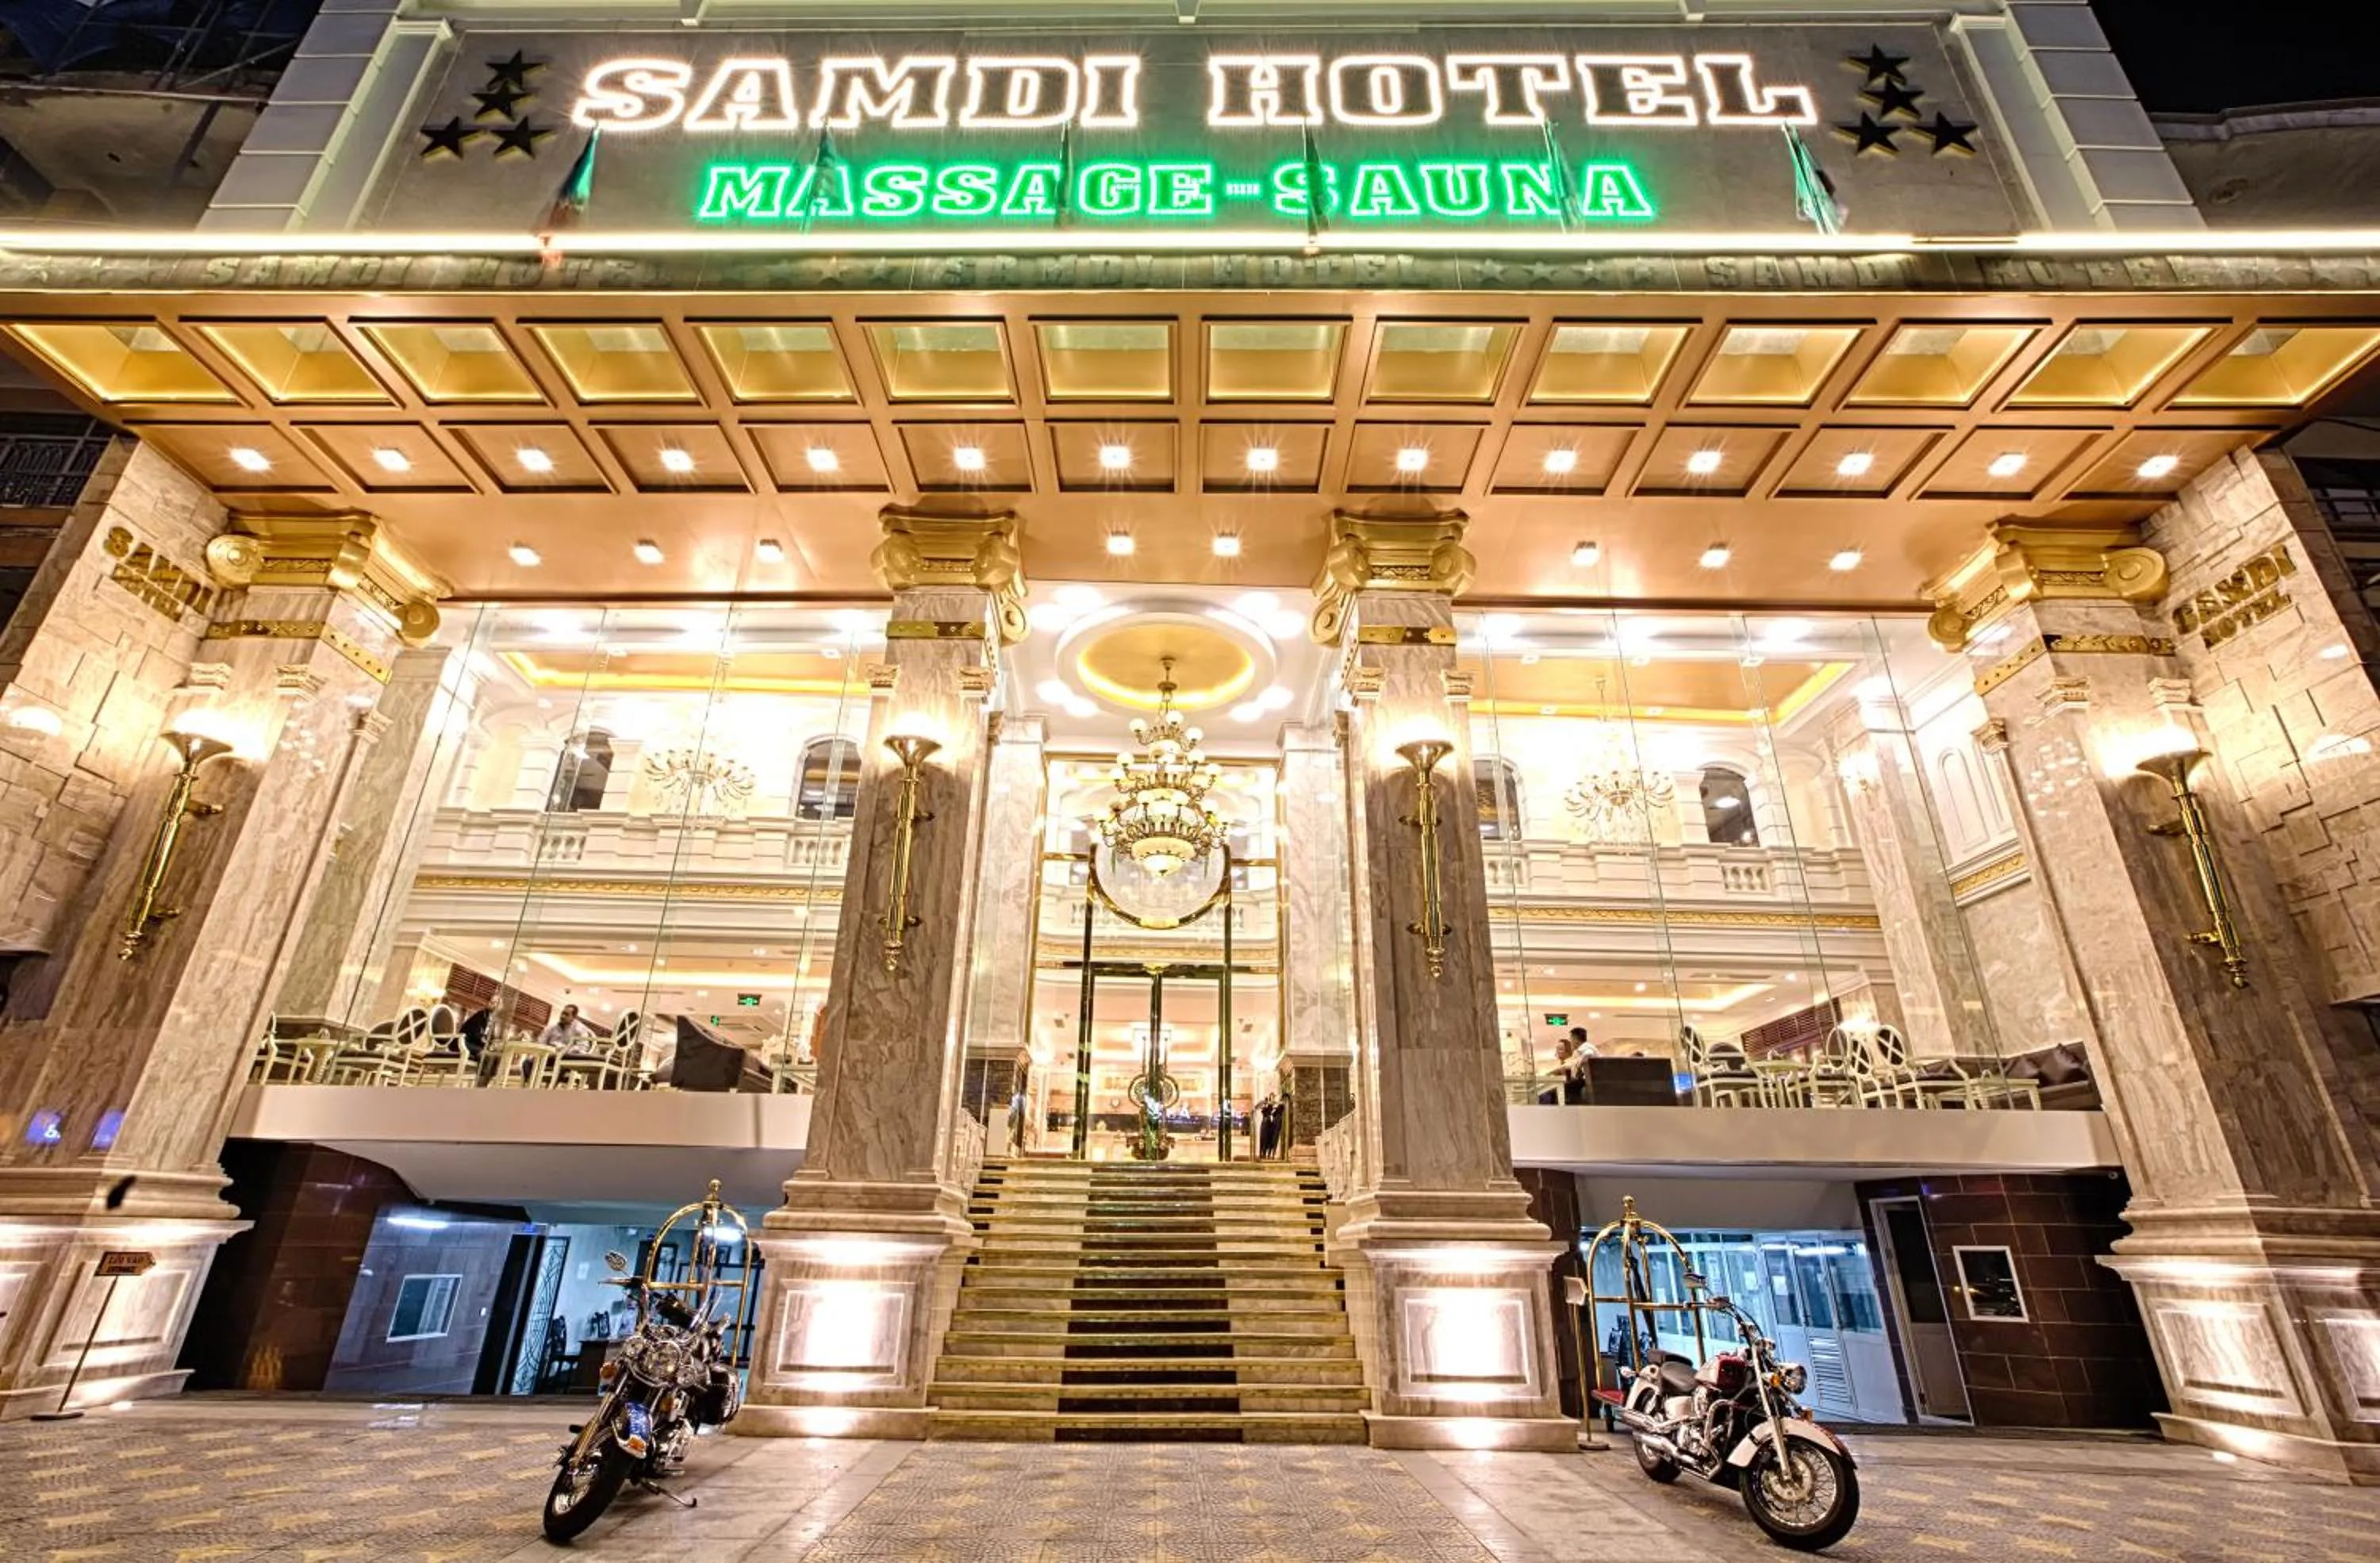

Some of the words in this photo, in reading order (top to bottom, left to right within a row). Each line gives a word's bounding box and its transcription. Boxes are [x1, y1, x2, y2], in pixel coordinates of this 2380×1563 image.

[570, 54, 1142, 132] SAMDI
[1206, 52, 1819, 126] HOTEL
[200, 255, 412, 286] SAMDI
[2172, 543, 2297, 636] SAMDI
